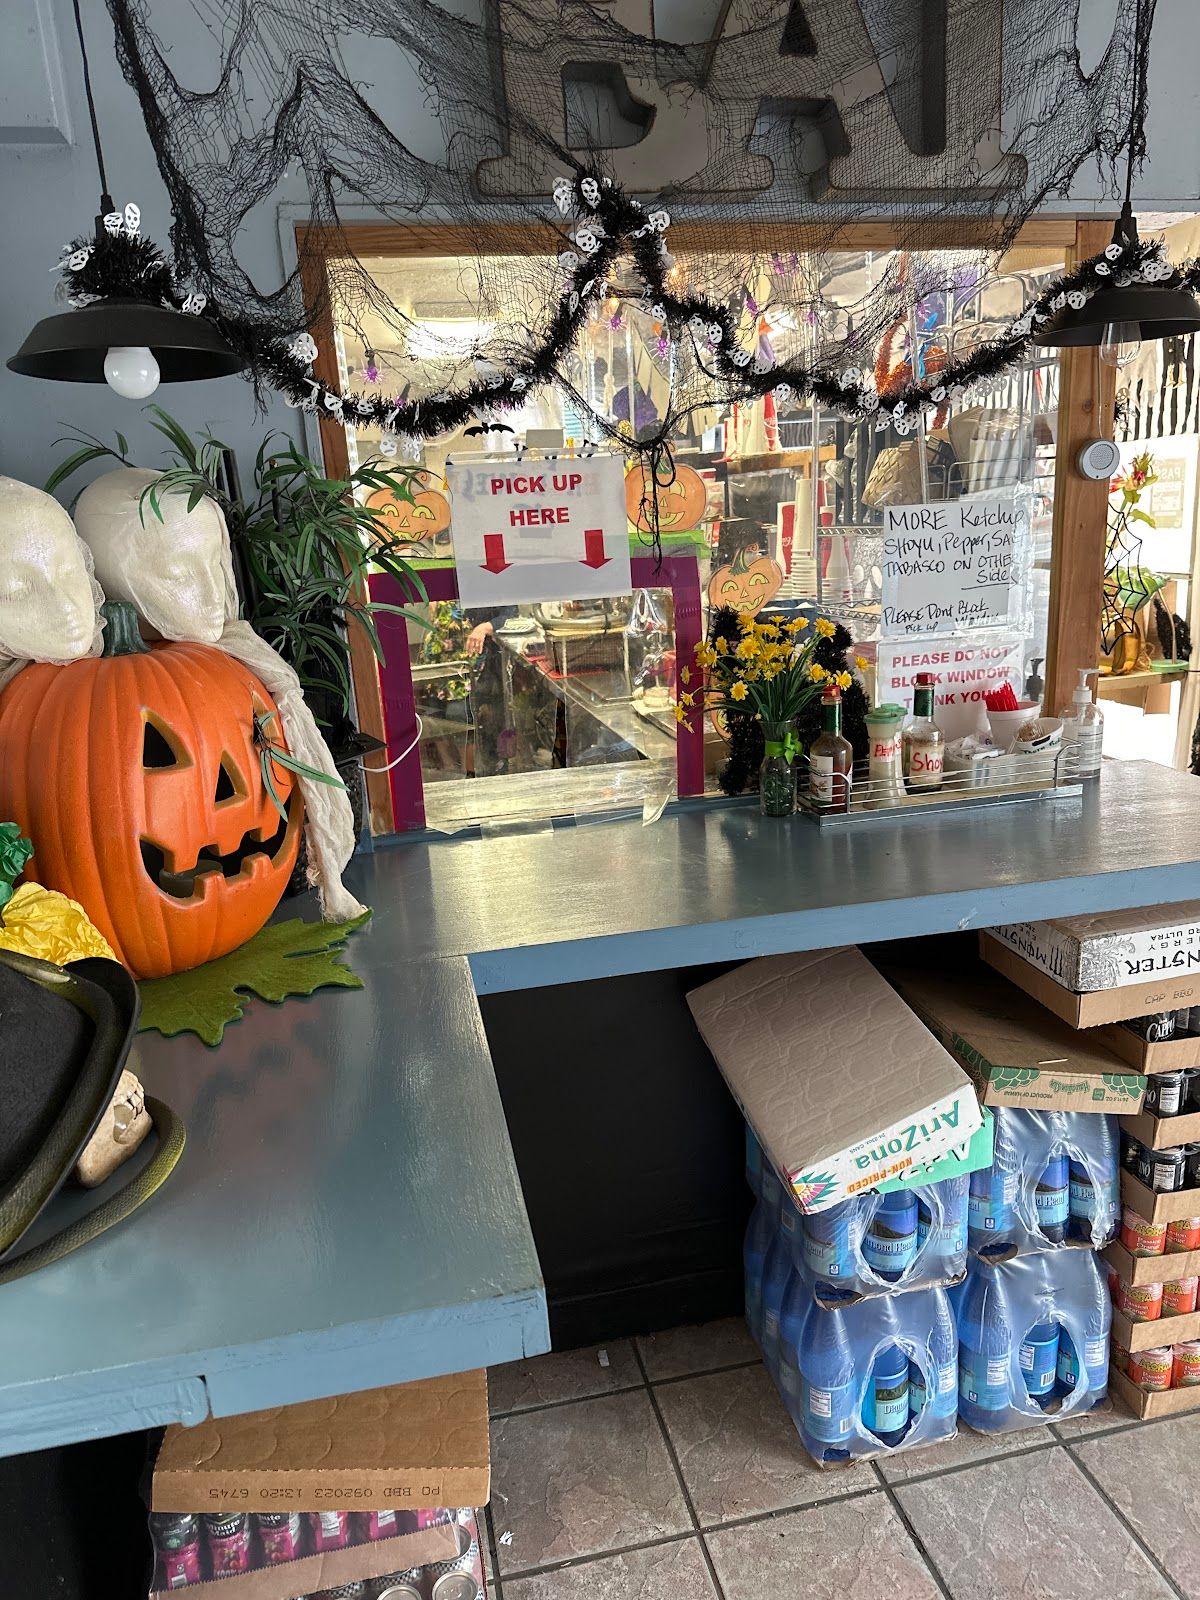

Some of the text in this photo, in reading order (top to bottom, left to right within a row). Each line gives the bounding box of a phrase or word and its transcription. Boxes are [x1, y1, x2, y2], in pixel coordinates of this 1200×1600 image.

[491, 476, 545, 495] PICK
[552, 473, 583, 492] UP
[509, 507, 570, 527] HERE
[889, 503, 1025, 533] MORE Ketchup
[883, 560, 945, 578] TABASCO
[953, 557, 972, 571] ON
[892, 647, 1009, 668] PLEASE DO NOT
[947, 666, 1010, 684] WINDOW
[903, 693, 956, 710] TNK
[1148, 936, 1200, 951] ERGY
[1150, 929, 1183, 941] ULTRA
[855, 1099, 960, 1170] AriZona
[847, 1156, 913, 1194] NON-PRICED
[209, 1488, 249, 1499] 6745
[259, 1488, 303, 1499] 13:20
[314, 1488, 373, 1499] 092023
[383, 1487, 412, 1497] BBD
